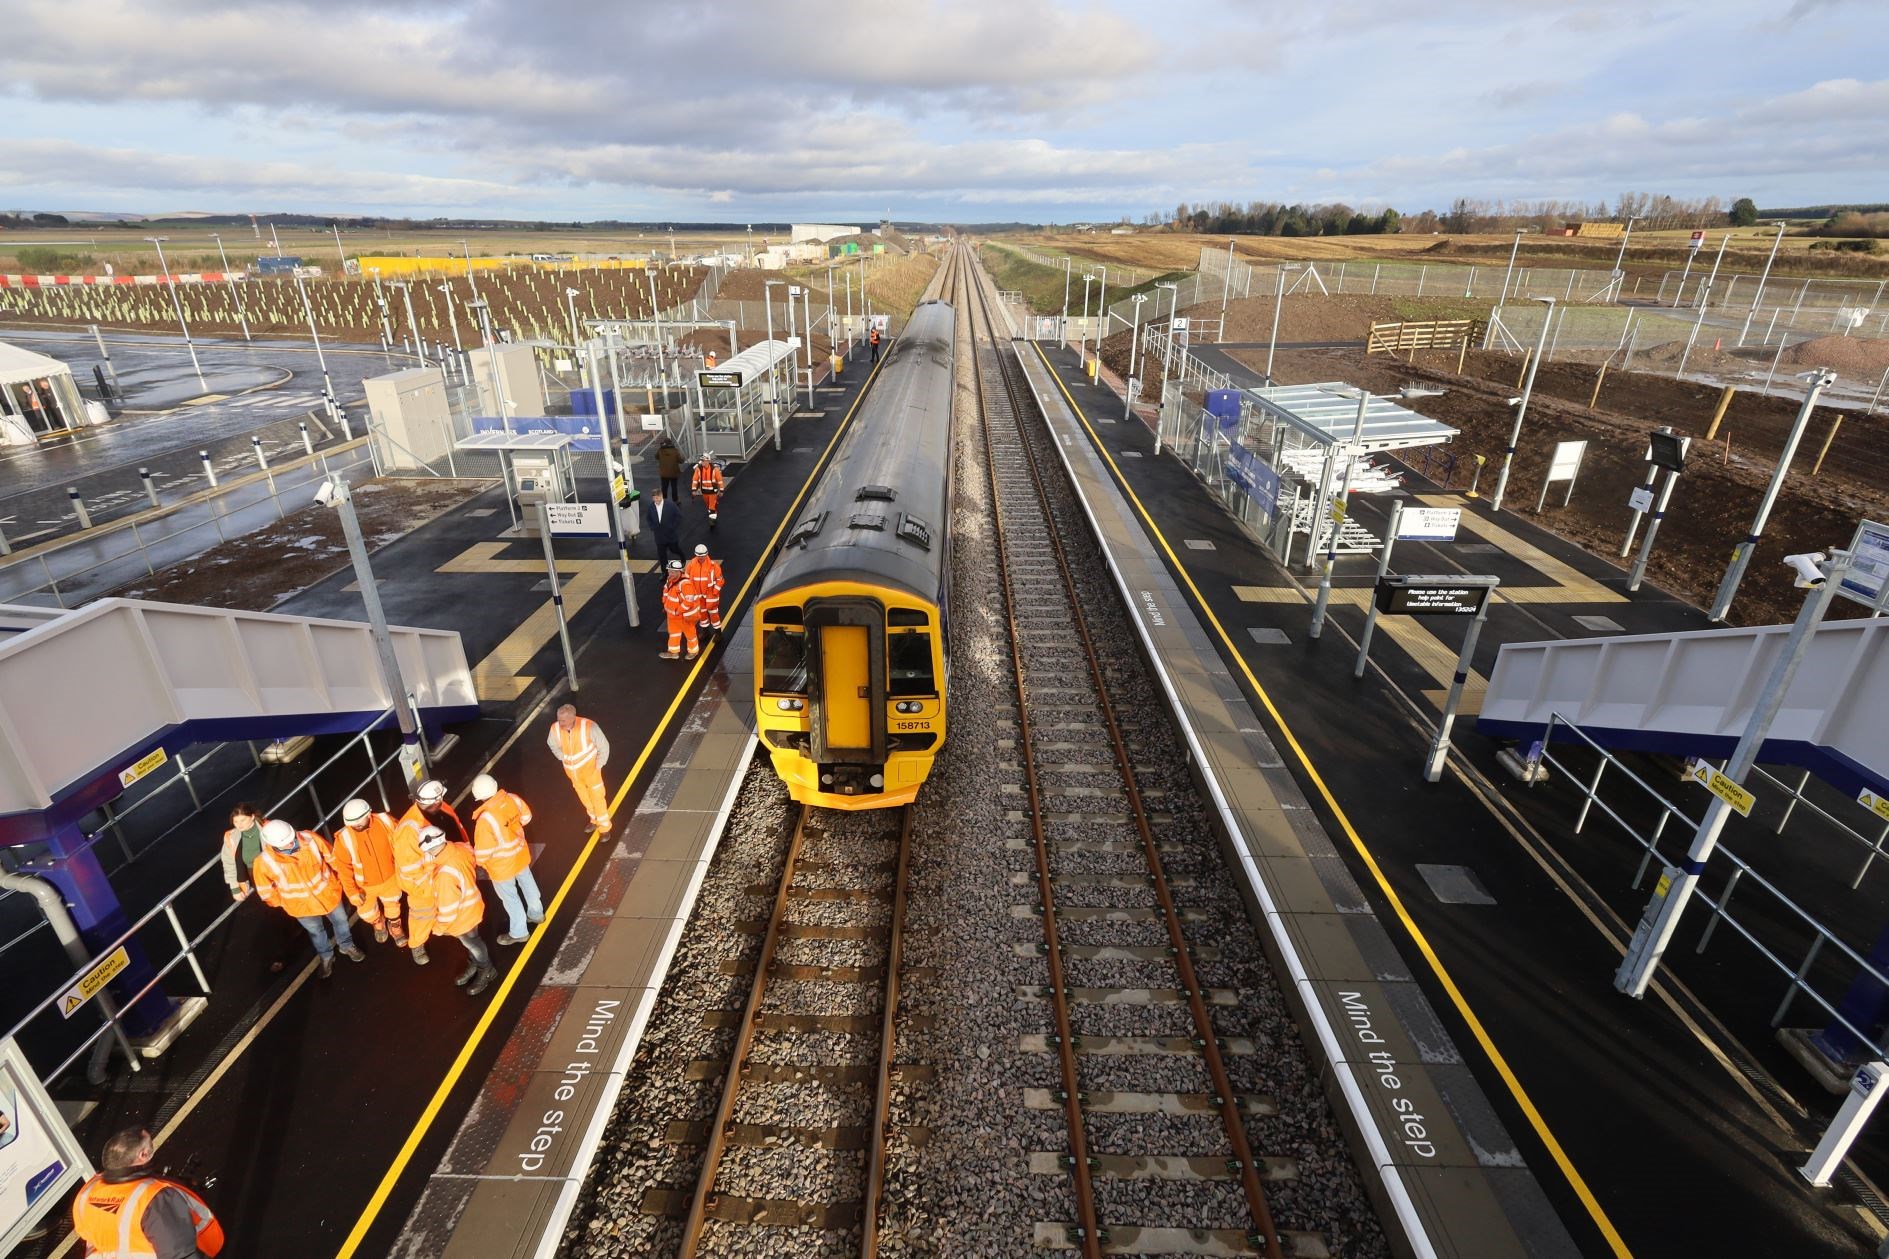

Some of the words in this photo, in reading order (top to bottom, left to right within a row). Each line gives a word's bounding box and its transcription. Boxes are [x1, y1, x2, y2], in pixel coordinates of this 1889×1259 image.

[1177, 319, 1183, 327] 2
[1141, 591, 1153, 601] step
[1146, 603, 1158, 611] the
[1149, 611, 1165, 625] Mind
[896, 721, 930, 730] 158713
[137, 753, 160, 769] Caution
[1711, 782, 1724, 794] Mind
[1724, 792, 1733, 801] the
[1733, 800, 1746, 811] step
[1714, 775, 1743, 799] Caution
[82, 959, 115, 988] Caution
[85, 981, 101, 995] Mind
[101, 972, 111, 981] the
[111, 960, 125, 973] step
[576, 1000, 620, 1053] Mind
[554, 1061, 591, 1101] the
[1338, 991, 1385, 1043] Mind
[1369, 1051, 1401, 1090] the
[1392, 1098, 1436, 1158] step
[518, 1109, 564, 1171] step
